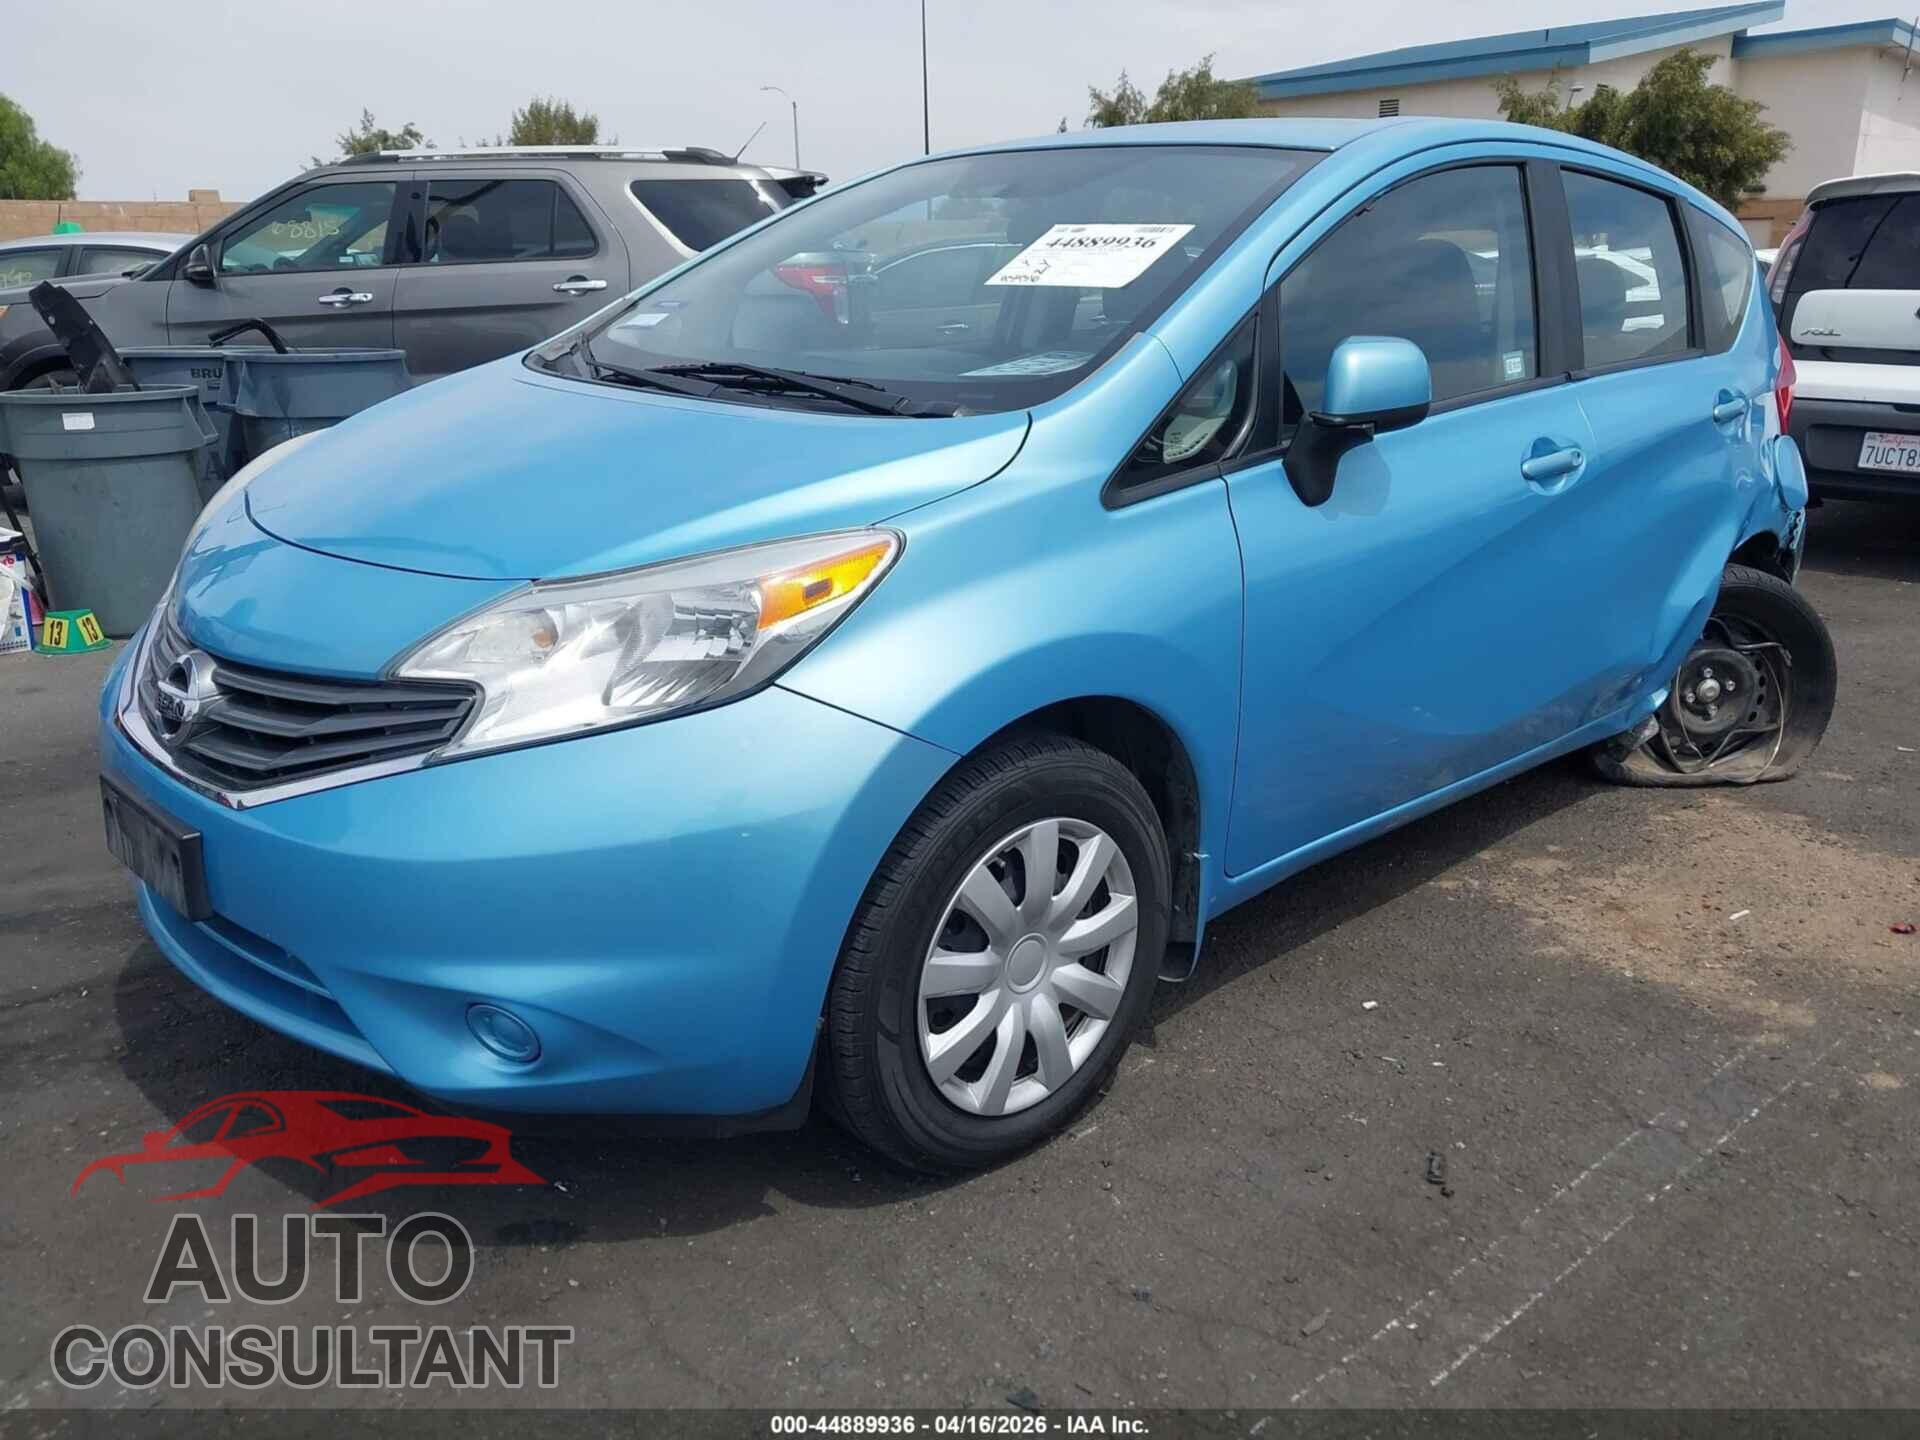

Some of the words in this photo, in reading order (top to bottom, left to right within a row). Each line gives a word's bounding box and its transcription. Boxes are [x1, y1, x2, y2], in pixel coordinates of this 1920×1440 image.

[1045, 236, 1160, 249] 44889936
[1865, 445, 1920, 467] 7UCT8
[50, 620, 64, 646] 13
[81, 616, 99, 642] 13
